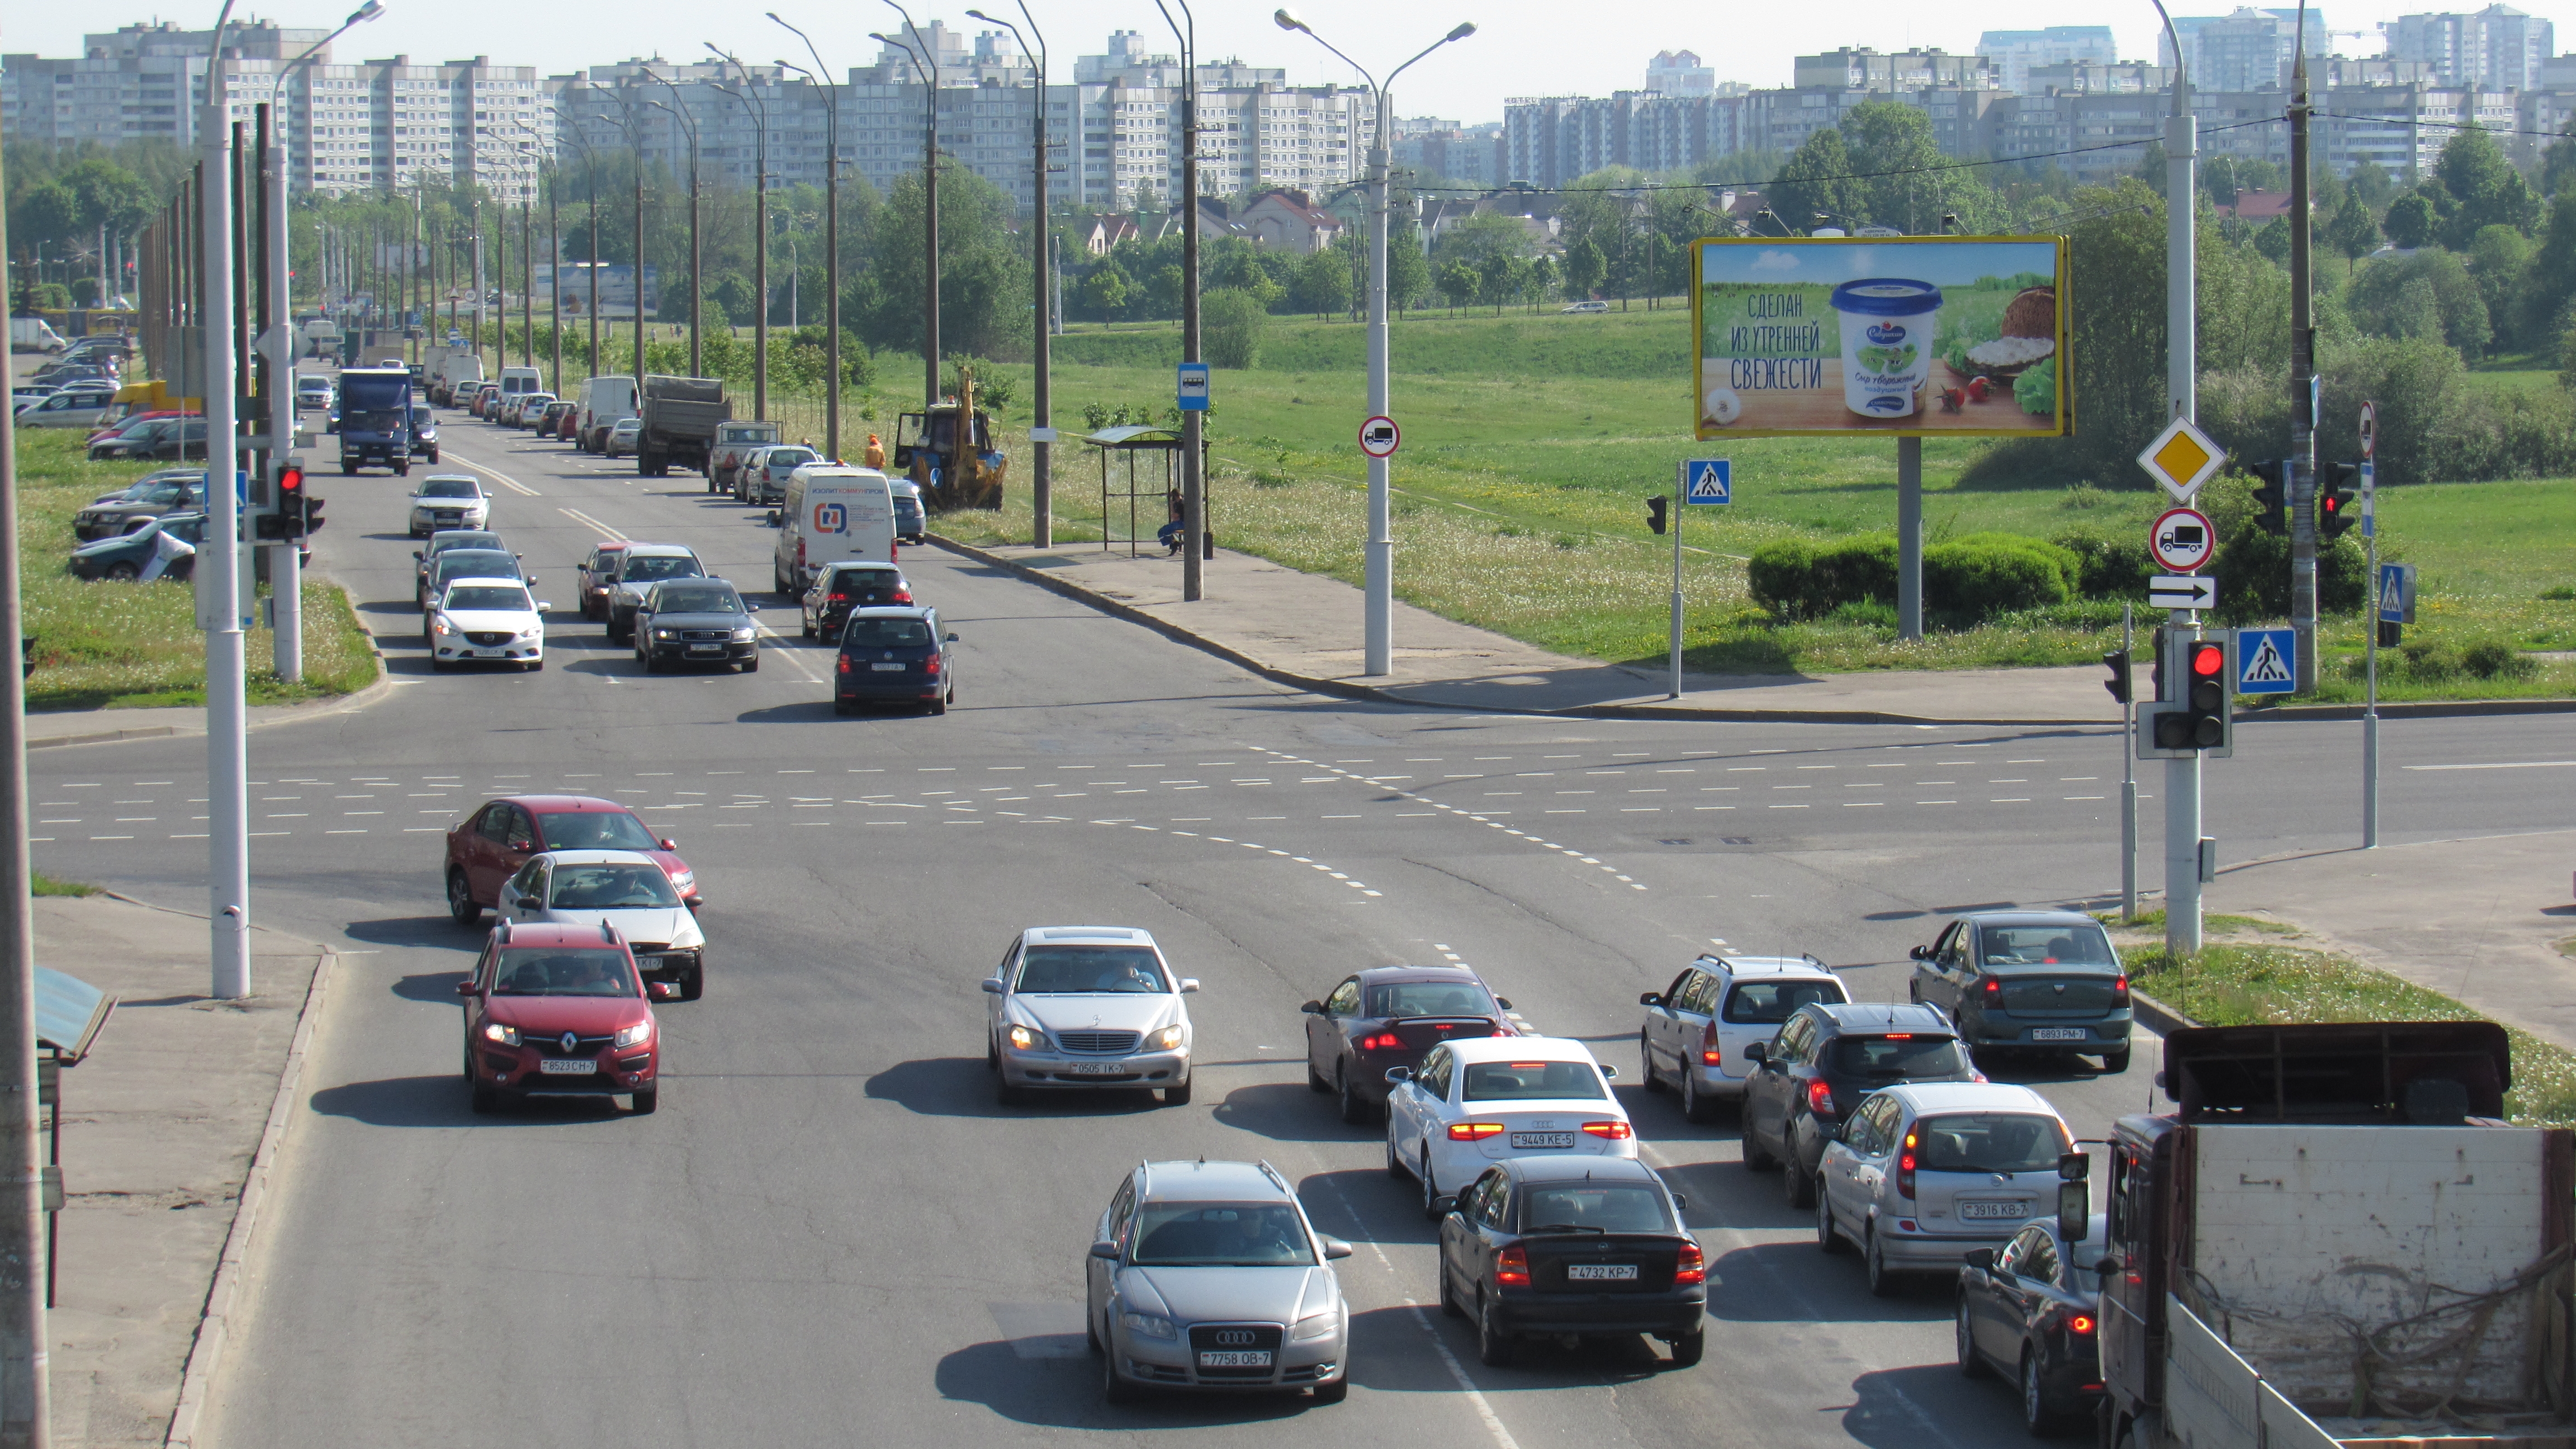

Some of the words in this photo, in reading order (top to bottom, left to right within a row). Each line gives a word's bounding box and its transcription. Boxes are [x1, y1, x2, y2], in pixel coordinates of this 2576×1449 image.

[1748, 293, 1802, 320] СДЕЛАН
[1731, 326, 1748, 352] ИЗ
[1753, 320, 1820, 352] УТРЕННЕЙ
[1731, 358, 1821, 390] СВЕЖЕСТИ
[1855, 372, 1871, 384] Сыр
[1873, 373, 1916, 386] творожный
[2041, 1030, 2061, 1039] 6893
[2062, 1030, 2084, 1038] PM-7
[550, 1061, 570, 1071] 8523
[572, 1061, 595, 1071] CH-7
[1079, 1064, 1100, 1073] 0505
[1105, 1064, 1126, 1073] IK-7
[1522, 1135, 1545, 1145] 9449
[1548, 1135, 1571, 1145] KE-5
[1973, 1205, 1997, 1216] 3916
[2001, 1204, 2026, 1215] KB-7
[1579, 1267, 1604, 1278] 4732
[1608, 1267, 1635, 1278] KP-7
[1211, 1353, 1238, 1365] 7758
[1242, 1353, 1270, 1365] OB-7
